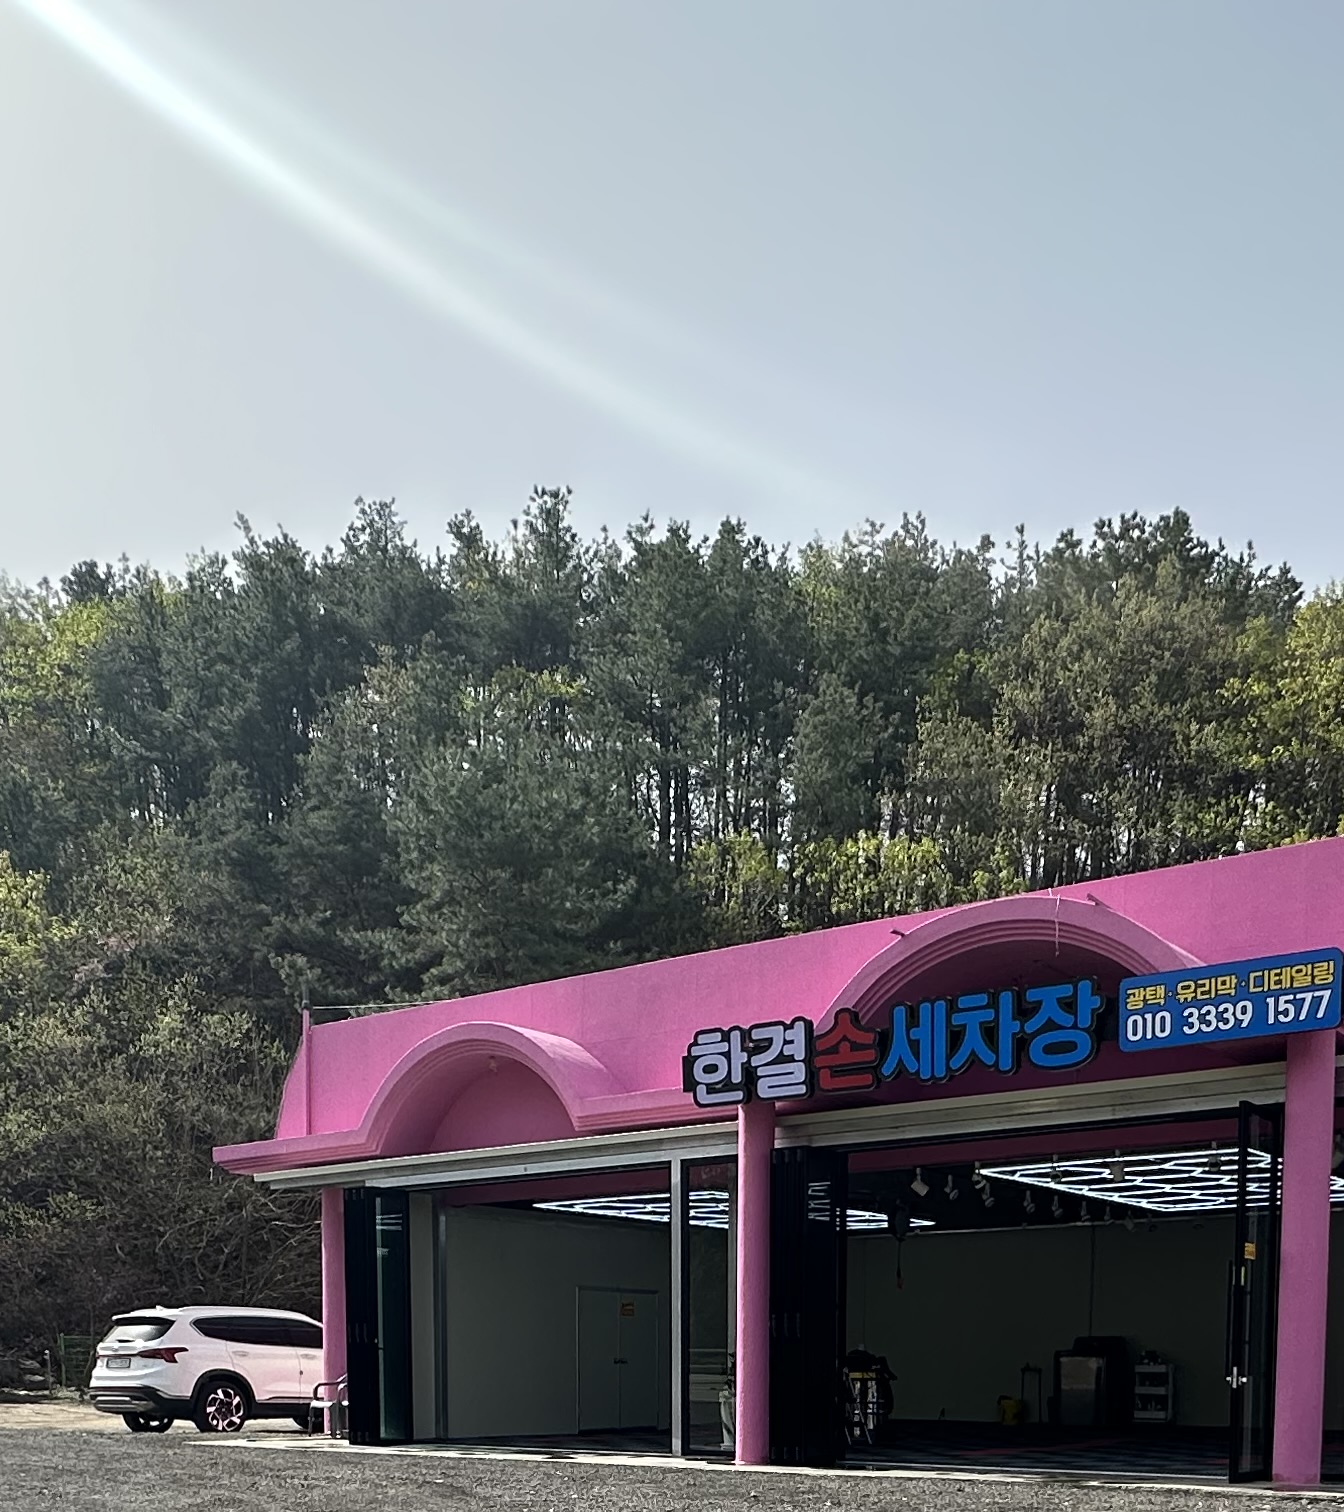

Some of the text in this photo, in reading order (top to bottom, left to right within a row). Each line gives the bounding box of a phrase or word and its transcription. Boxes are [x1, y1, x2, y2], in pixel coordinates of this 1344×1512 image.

[1126, 961, 1335, 1010] 광택 유리막 디테일링
[1126, 989, 1332, 1042] 010 3339 1577
